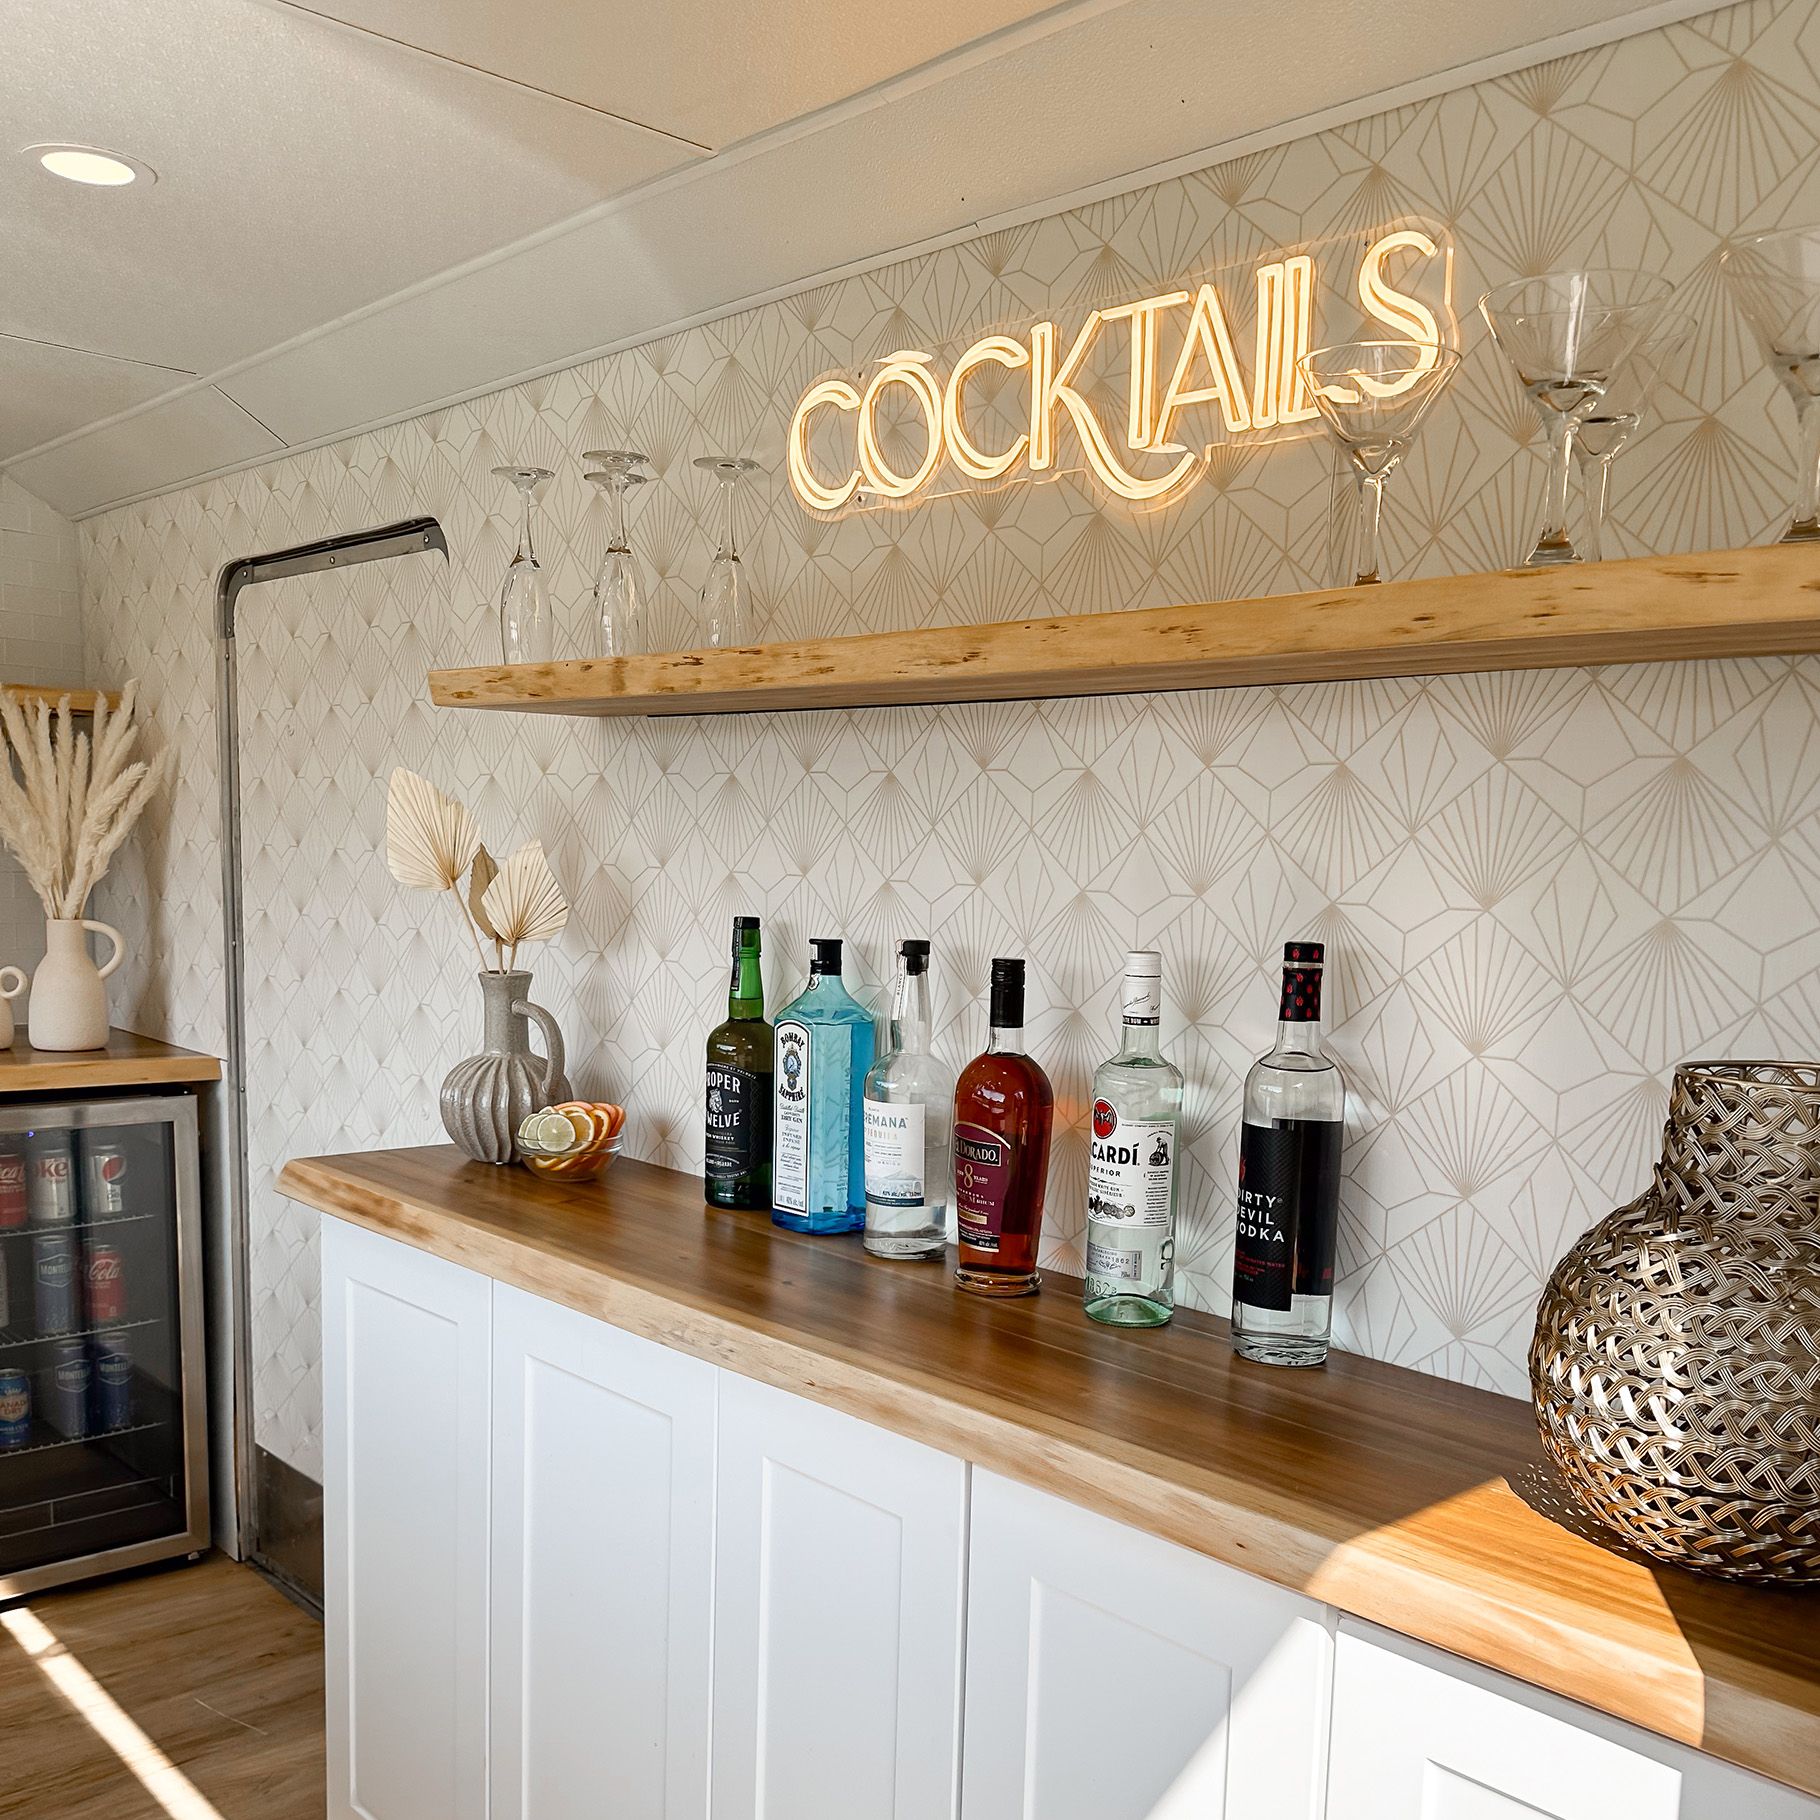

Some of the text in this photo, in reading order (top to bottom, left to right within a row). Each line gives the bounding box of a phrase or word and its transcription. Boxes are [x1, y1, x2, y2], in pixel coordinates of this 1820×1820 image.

[787, 230, 1440, 510] COCKTAILS
[780, 1032, 805, 1051] BOMBAY
[778, 1083, 805, 1102] SAPPHIRE
[963, 1164, 974, 1188] 8
[89, 1258, 120, 1281] Cola
